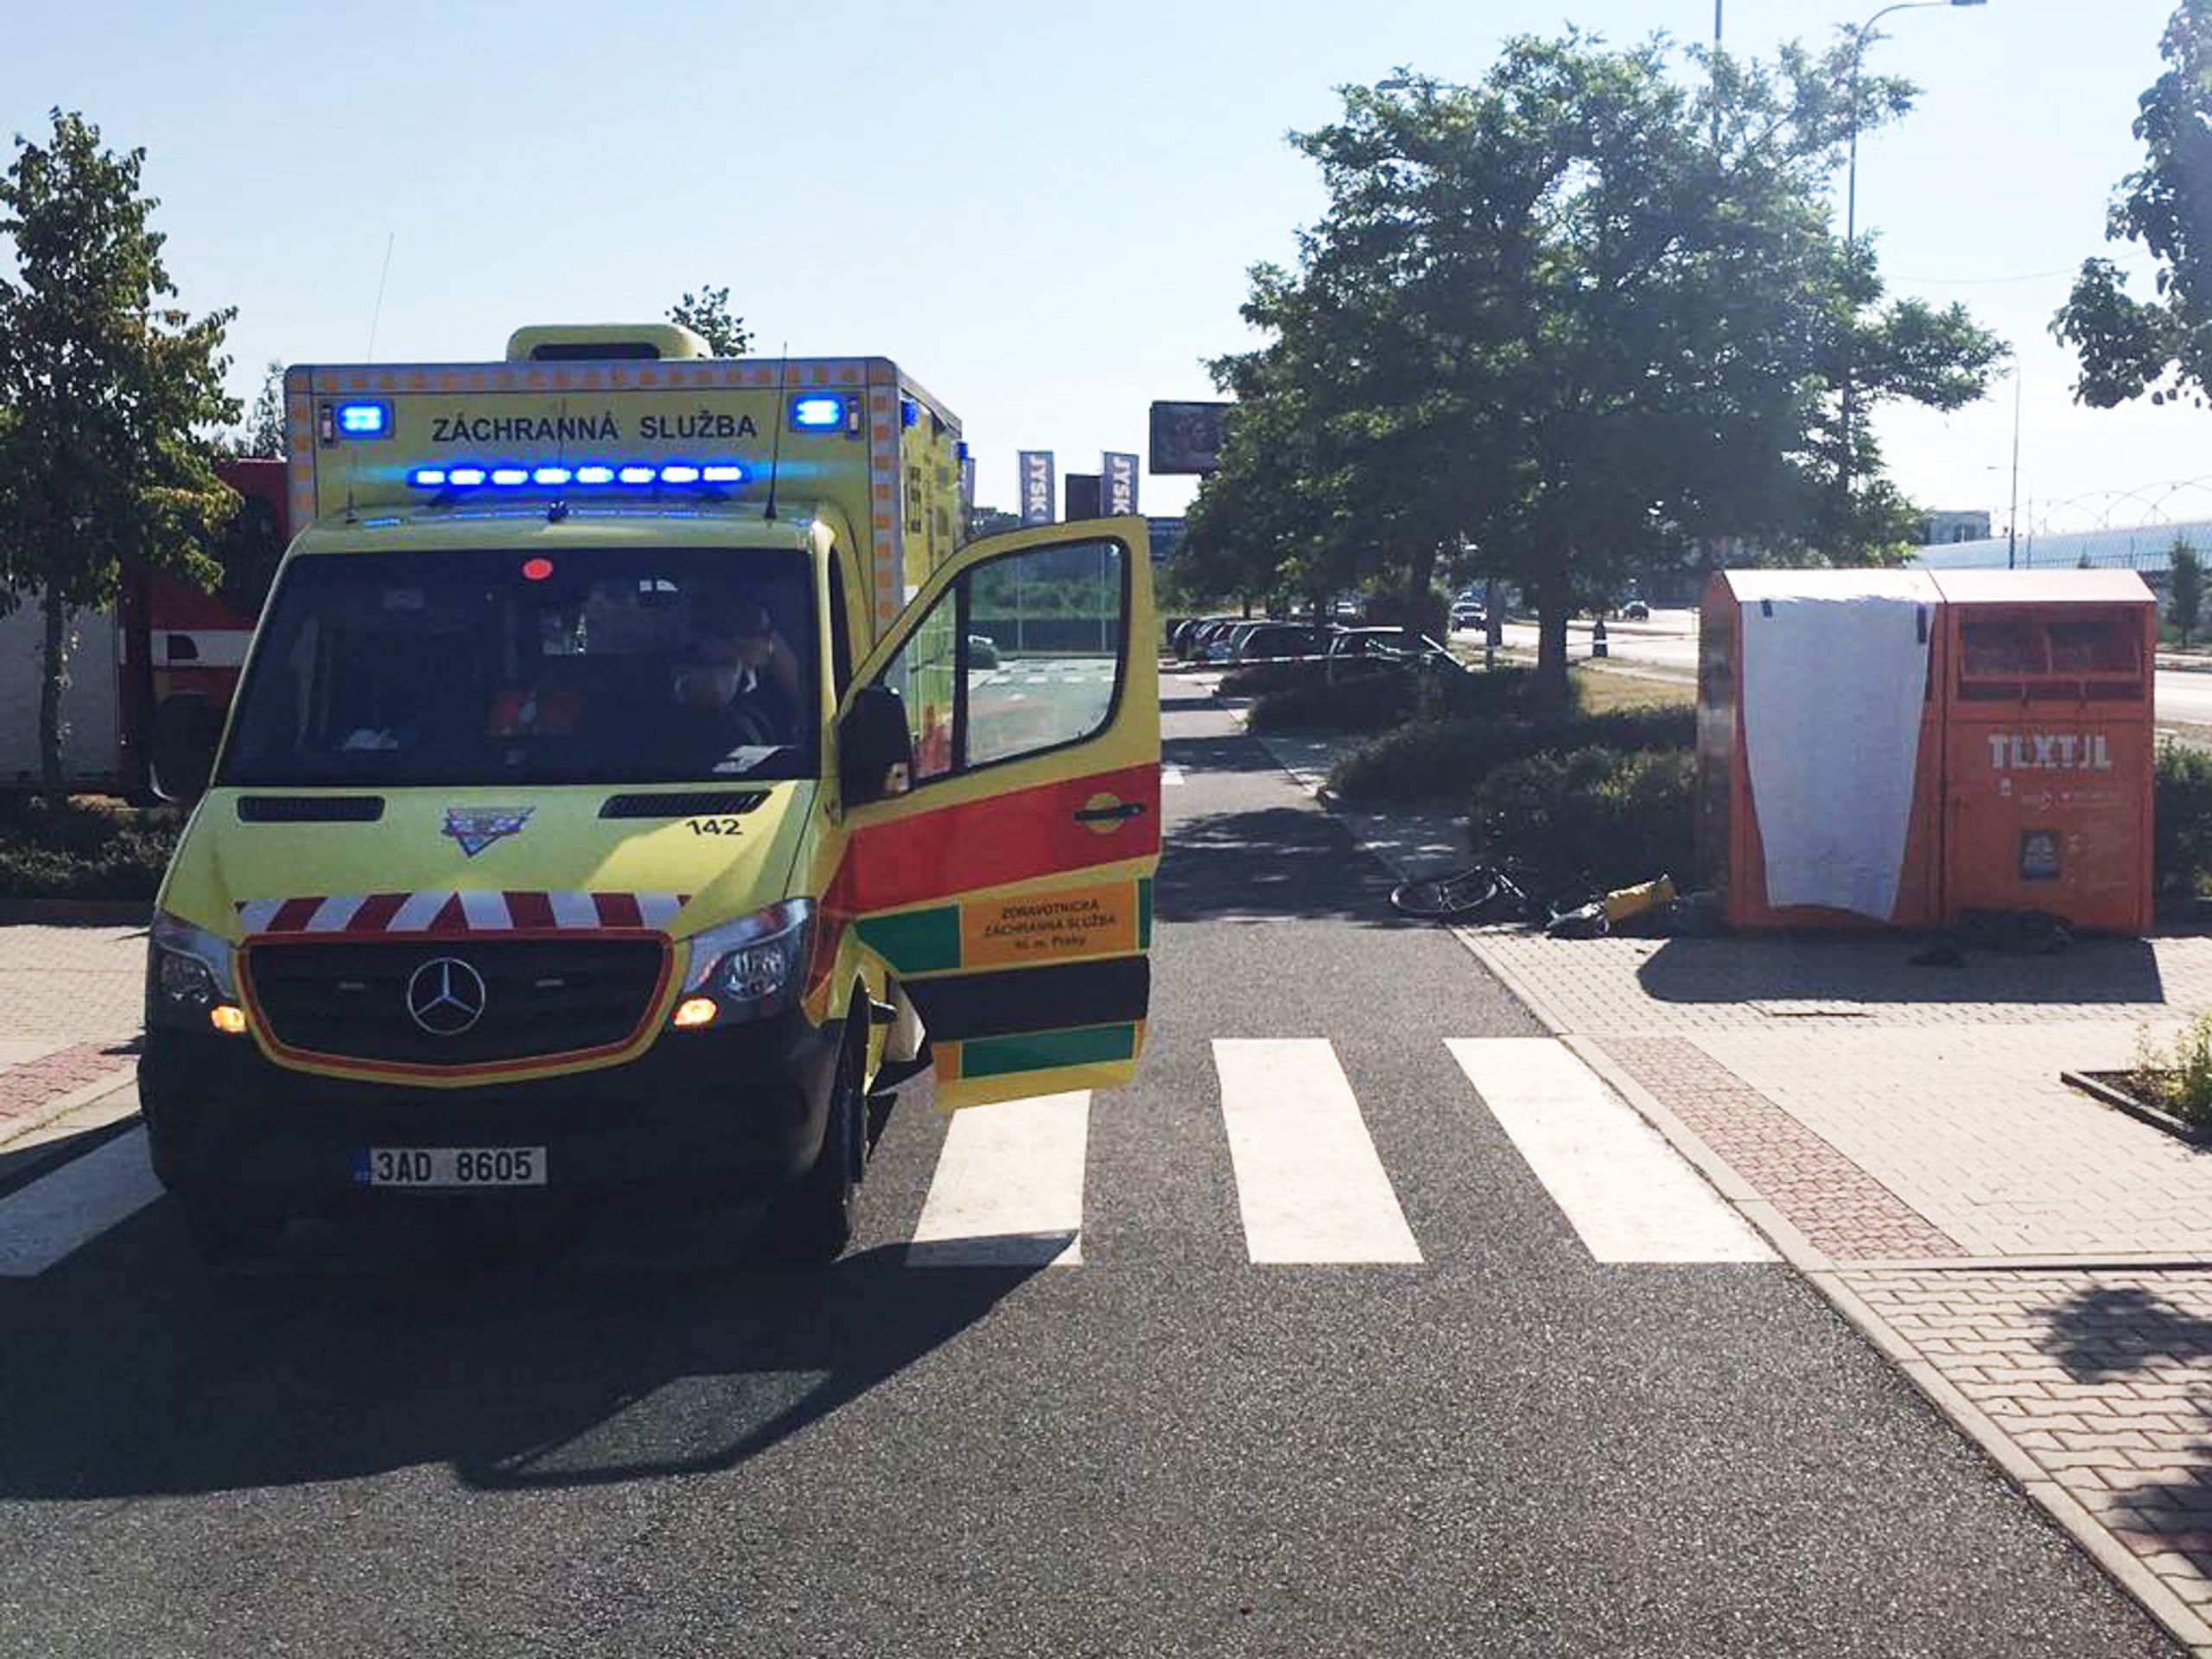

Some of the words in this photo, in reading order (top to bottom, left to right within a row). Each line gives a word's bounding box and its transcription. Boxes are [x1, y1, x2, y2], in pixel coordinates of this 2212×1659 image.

[432, 410, 620, 442] ZÁCHRANNÁ
[639, 410, 758, 439] SLUŽBA
[1029, 454, 1047, 512] JYSK
[1112, 455, 1131, 516] JYSK
[685, 817, 744, 836] 142
[377, 1151, 432, 1183] 3AD
[455, 1150, 533, 1182] 8605
